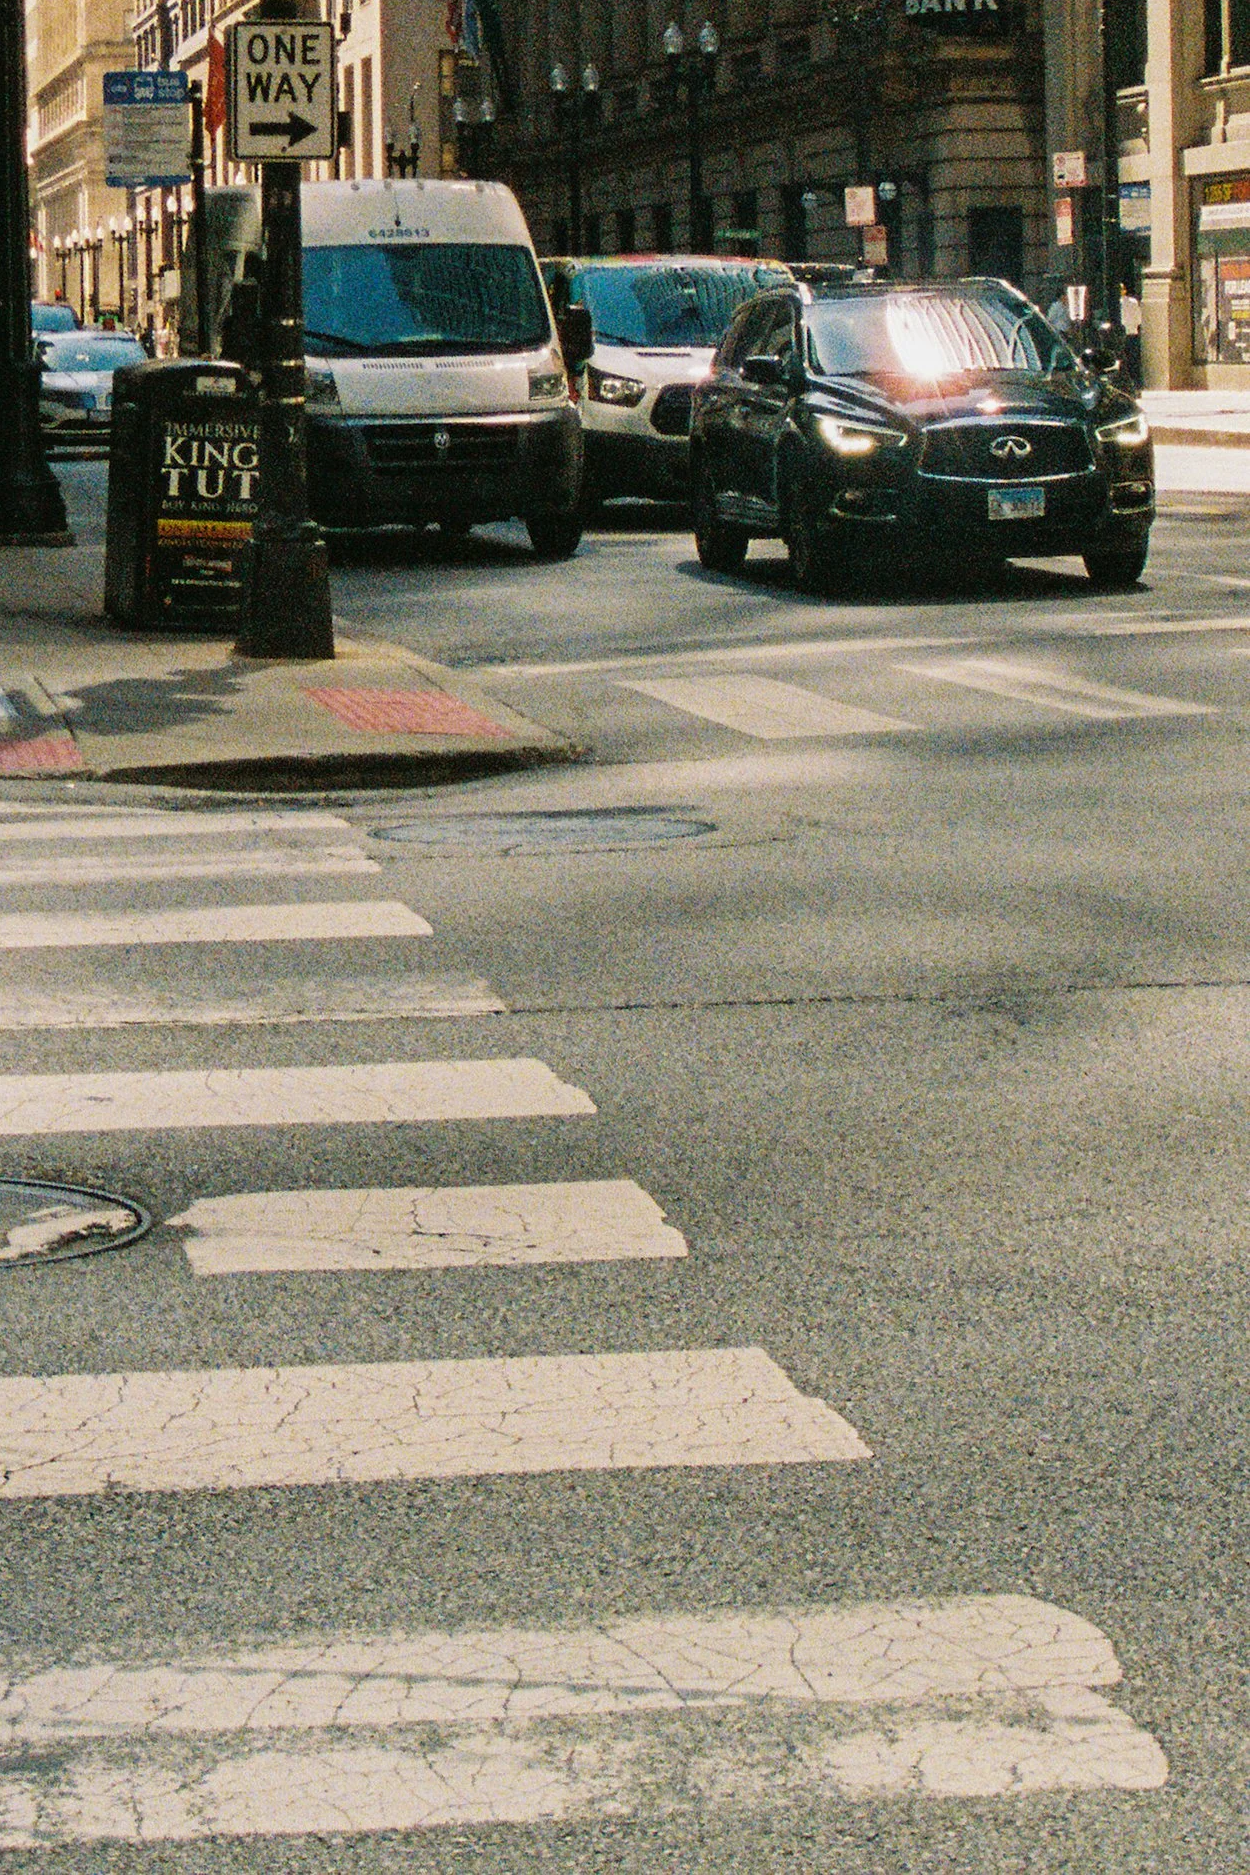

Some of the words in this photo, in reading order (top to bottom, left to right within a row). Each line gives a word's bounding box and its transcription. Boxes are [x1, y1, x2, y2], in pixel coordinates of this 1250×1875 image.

[248, 34, 321, 65] ONE
[157, 75, 180, 87] bus
[157, 86, 186, 101] stop
[246, 72, 322, 103] WAY
[165, 421, 261, 440] IMMERSIVE
[162, 435, 259, 469] KING
[160, 468, 261, 500] TUT
